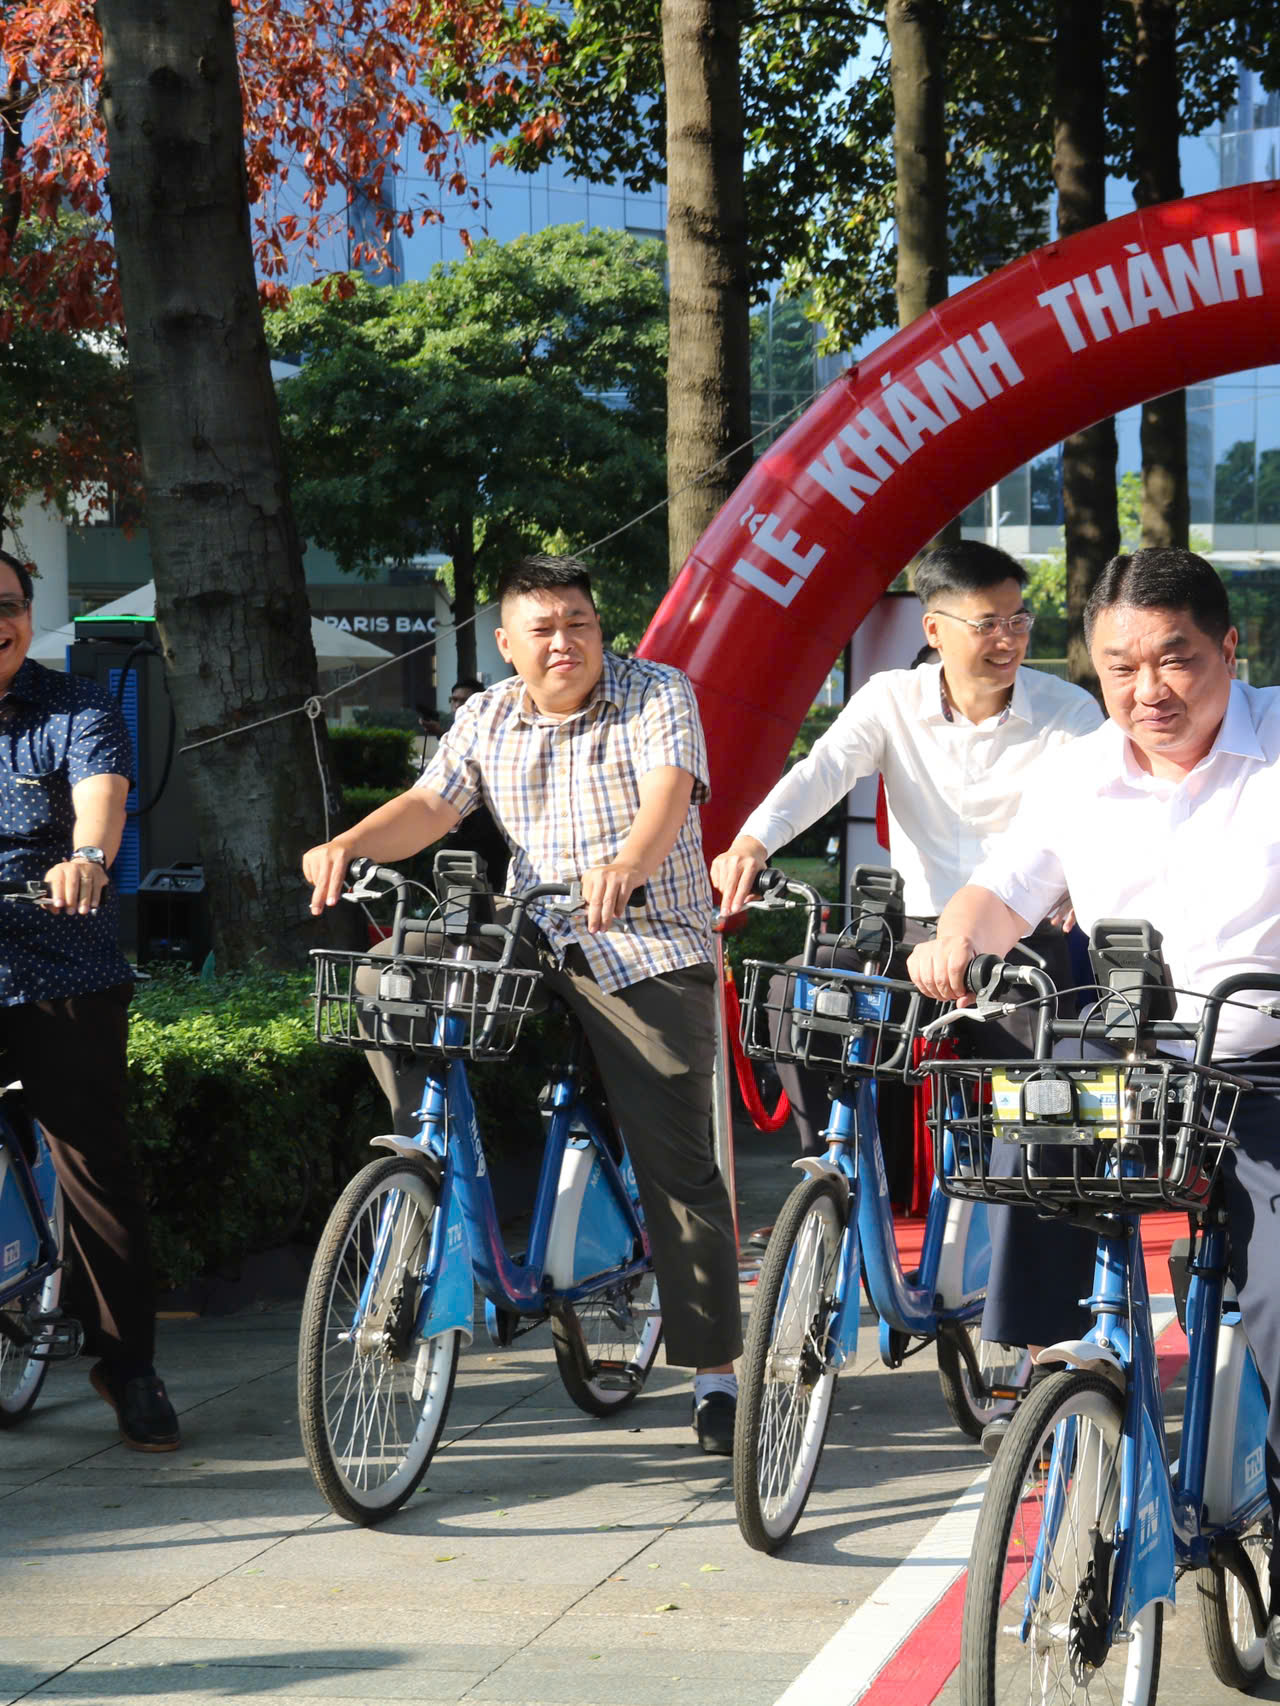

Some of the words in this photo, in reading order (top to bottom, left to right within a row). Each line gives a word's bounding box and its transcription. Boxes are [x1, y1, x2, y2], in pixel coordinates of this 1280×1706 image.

[732, 504, 826, 607] LỄ
[807, 321, 1025, 515] KHÁNH
[1037, 227, 1263, 353] THÀNH
[324, 616, 390, 632] PARIS
